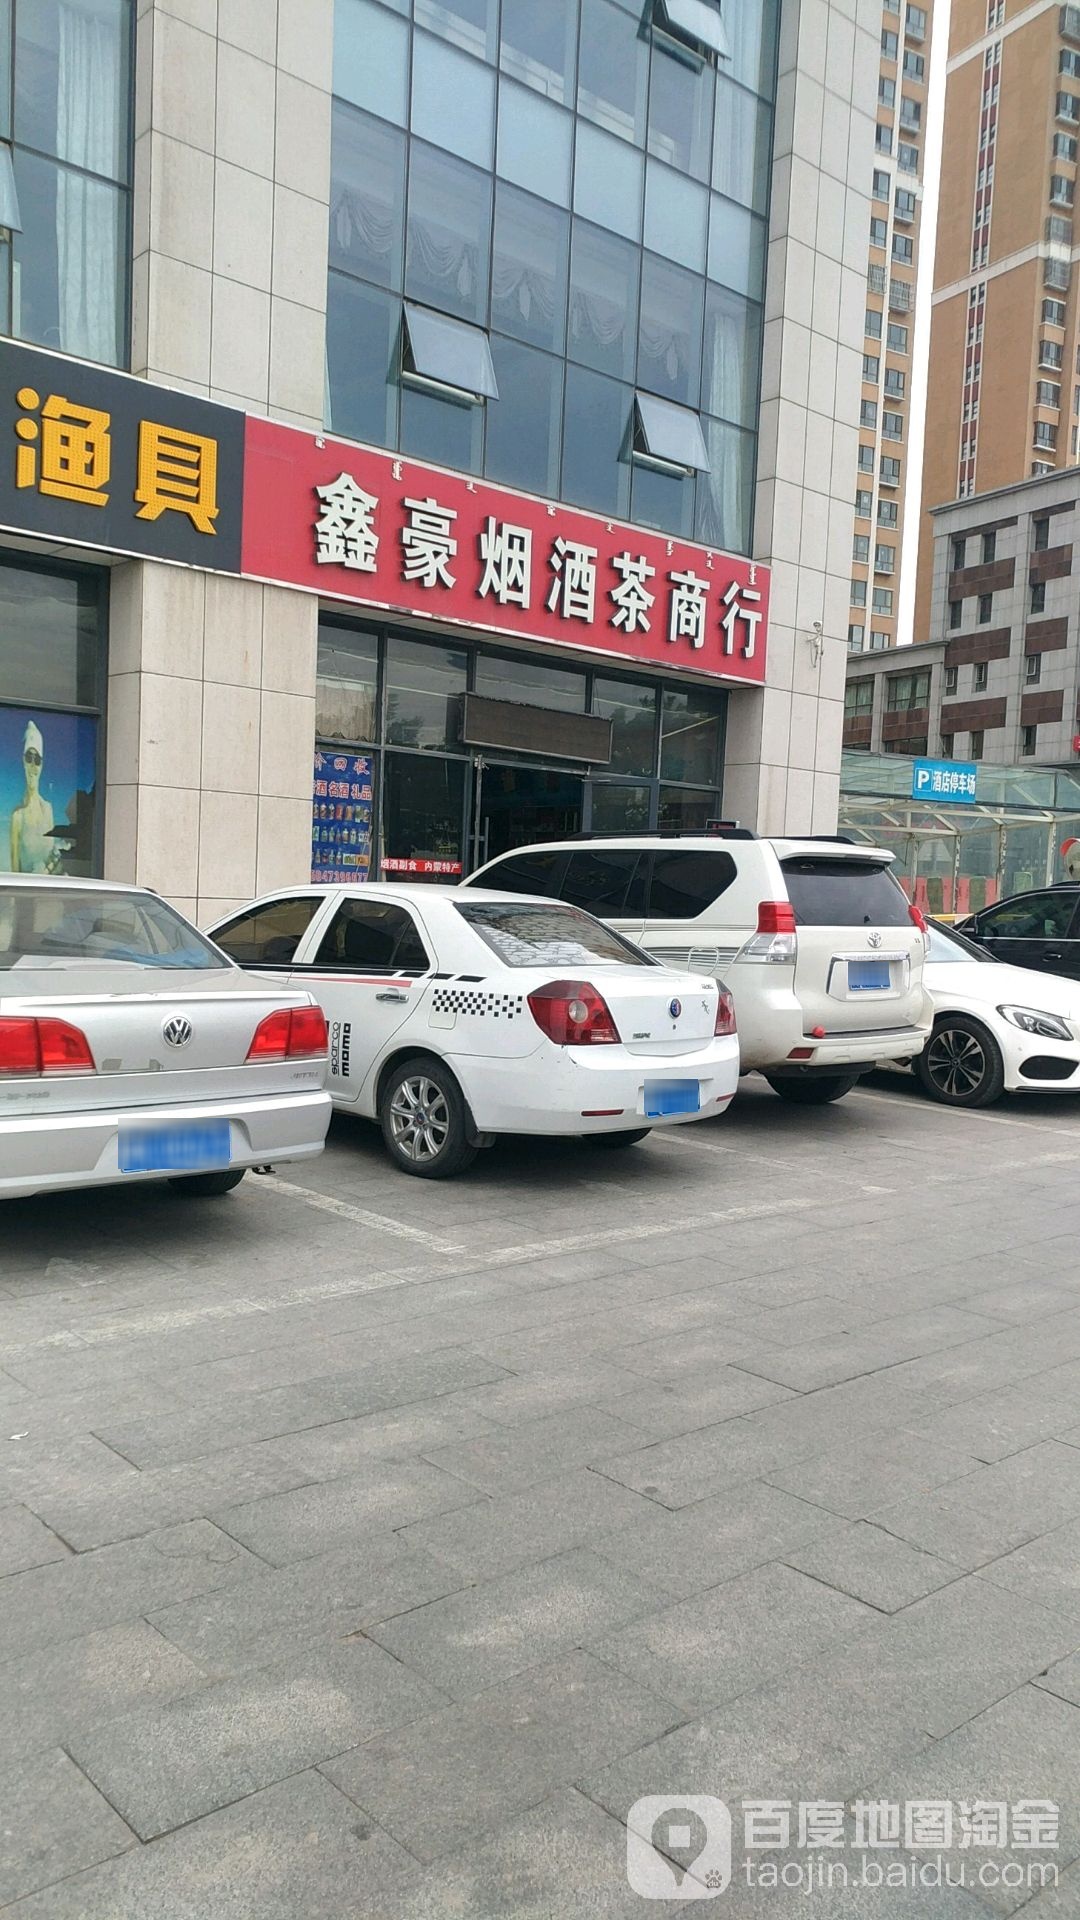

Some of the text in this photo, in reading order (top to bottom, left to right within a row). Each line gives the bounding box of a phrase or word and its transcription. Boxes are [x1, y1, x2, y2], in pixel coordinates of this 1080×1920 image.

[14, 387, 219, 536] 渔具
[314, 471, 762, 659] 鑫豪烟酒茶商行
[313, 779, 373, 801] 酒名酒礼品
[932, 770, 976, 795] 酒店停车场
[380, 858, 461, 873] 烟酒副食 内蒙特产
[331, 1021, 341, 1077] sparco
